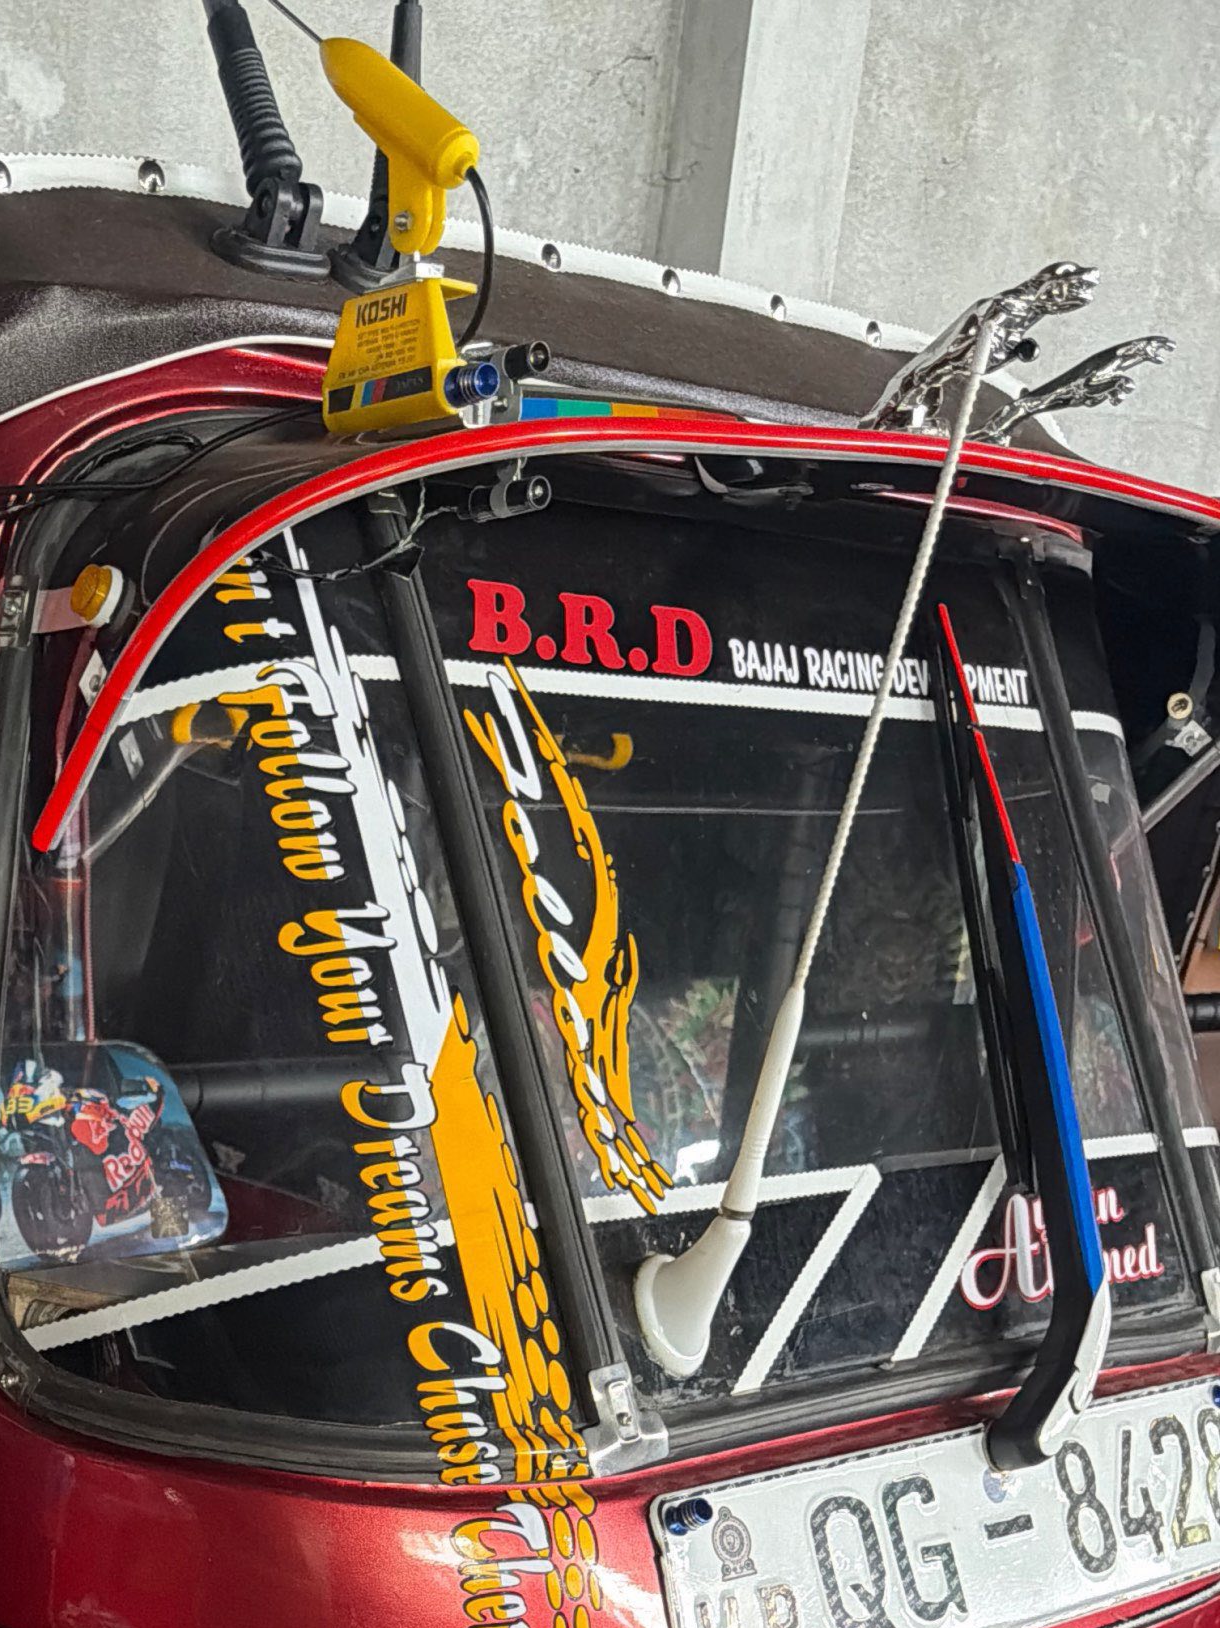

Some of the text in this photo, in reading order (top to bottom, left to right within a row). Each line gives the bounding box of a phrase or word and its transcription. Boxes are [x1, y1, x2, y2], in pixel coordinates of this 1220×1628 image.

[355, 292, 408, 328] KOSHI
[467, 579, 1028, 704] B.R.D BAJAJ RACING DEVPMENT
[216, 660, 357, 881] Follow
[277, 900, 398, 1046] Your
[340, 1061, 439, 1303] Dreams
[407, 1320, 508, 1486] Chase
